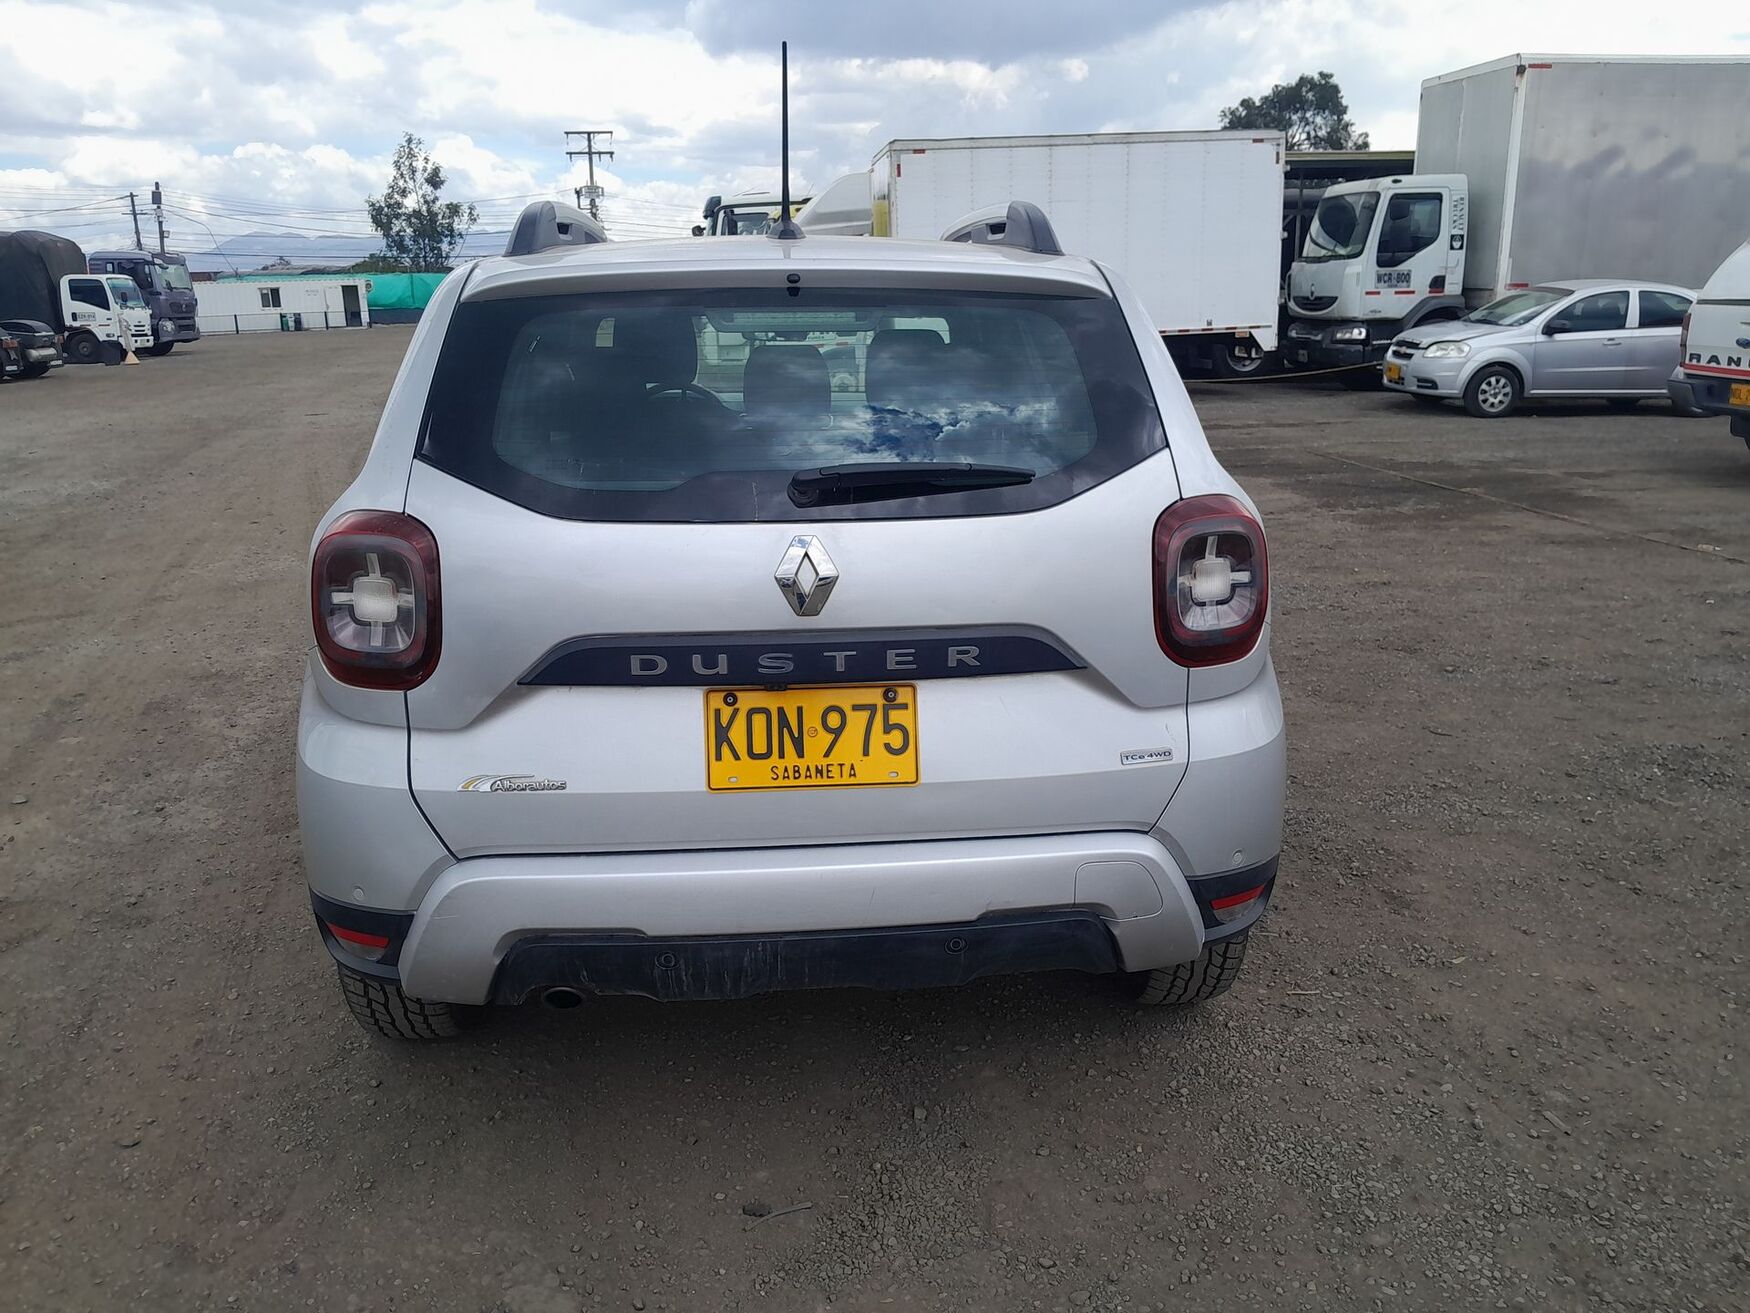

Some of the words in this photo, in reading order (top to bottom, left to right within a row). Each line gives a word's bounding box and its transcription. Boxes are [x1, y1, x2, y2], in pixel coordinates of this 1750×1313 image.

[1689, 352, 1750, 368] RAN
[629, 645, 981, 677] DUSTER
[713, 705, 805, 762] KON
[820, 702, 910, 758] 975
[1147, 750, 1172, 759] 4WD
[770, 762, 857, 781] SABANETA
[492, 779, 568, 792] Alborautos
